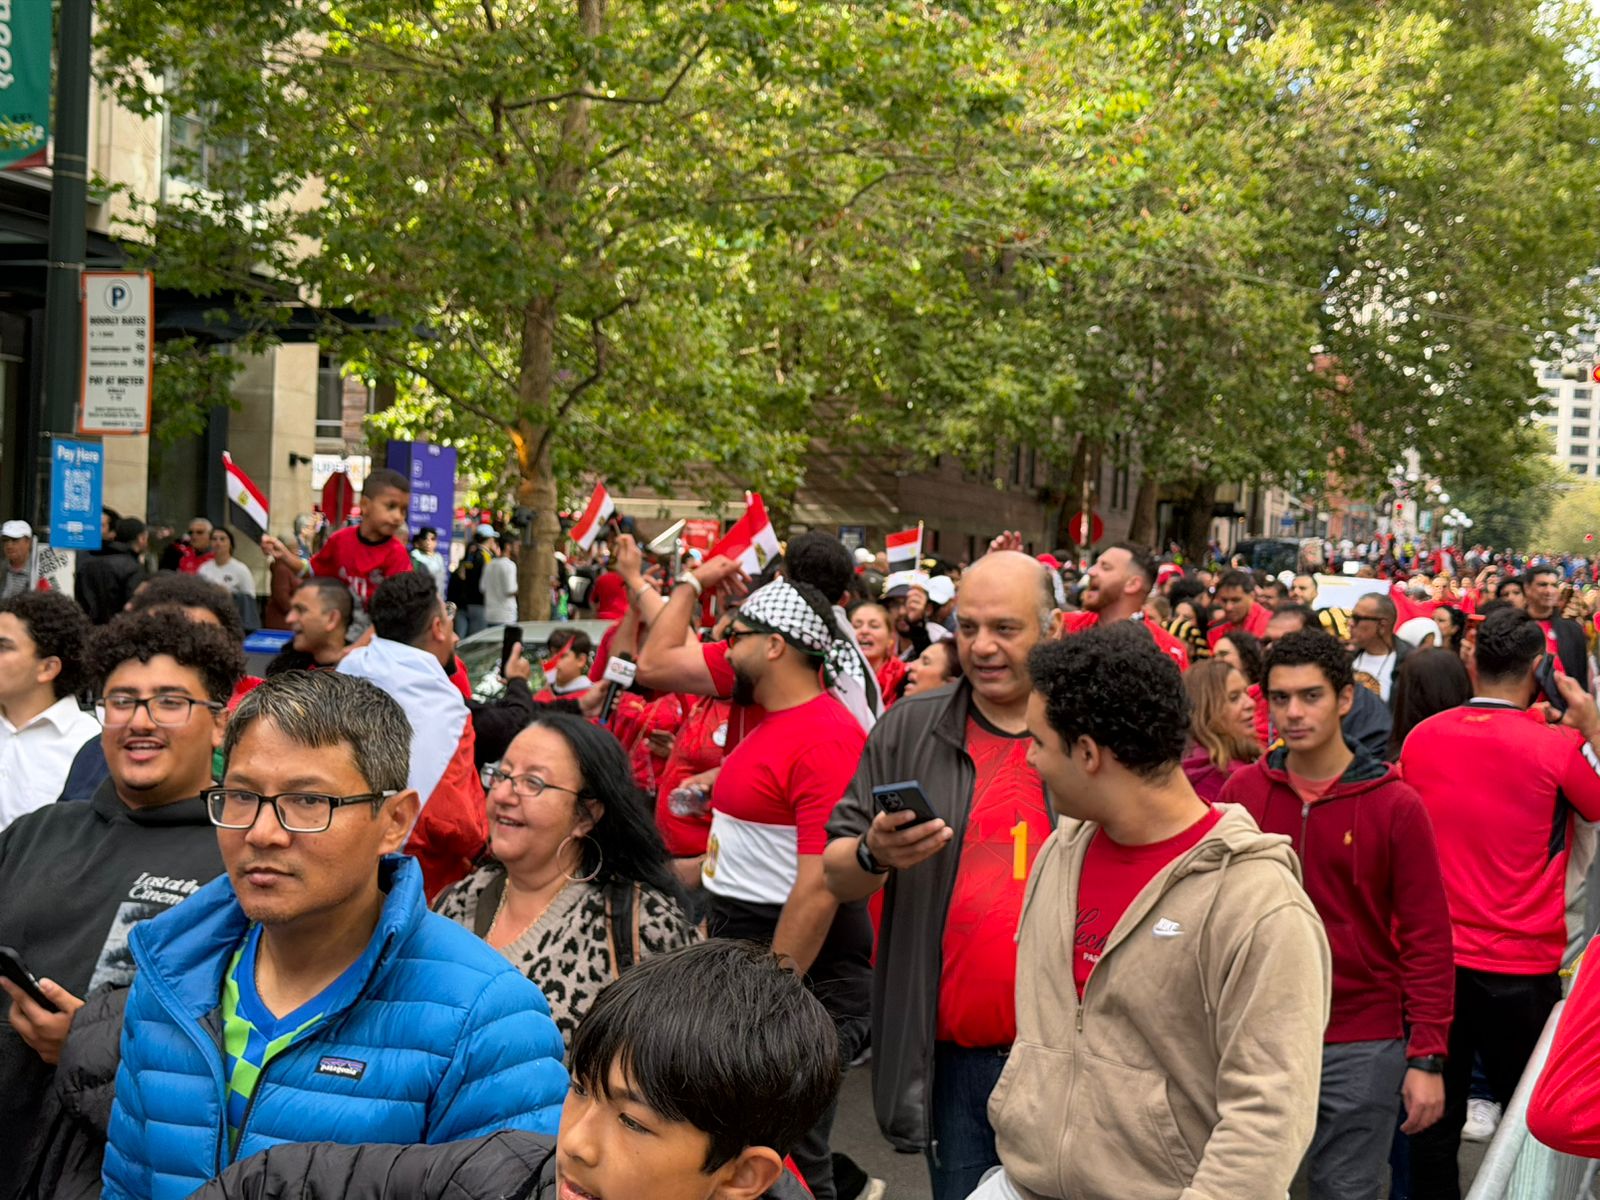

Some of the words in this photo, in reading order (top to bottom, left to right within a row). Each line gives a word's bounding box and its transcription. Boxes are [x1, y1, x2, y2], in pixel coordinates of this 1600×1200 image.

[111, 286, 125, 307] P
[57, 445, 75, 463] Pay
[76, 447, 99, 463] Here
[1010, 821, 1027, 880] 1
